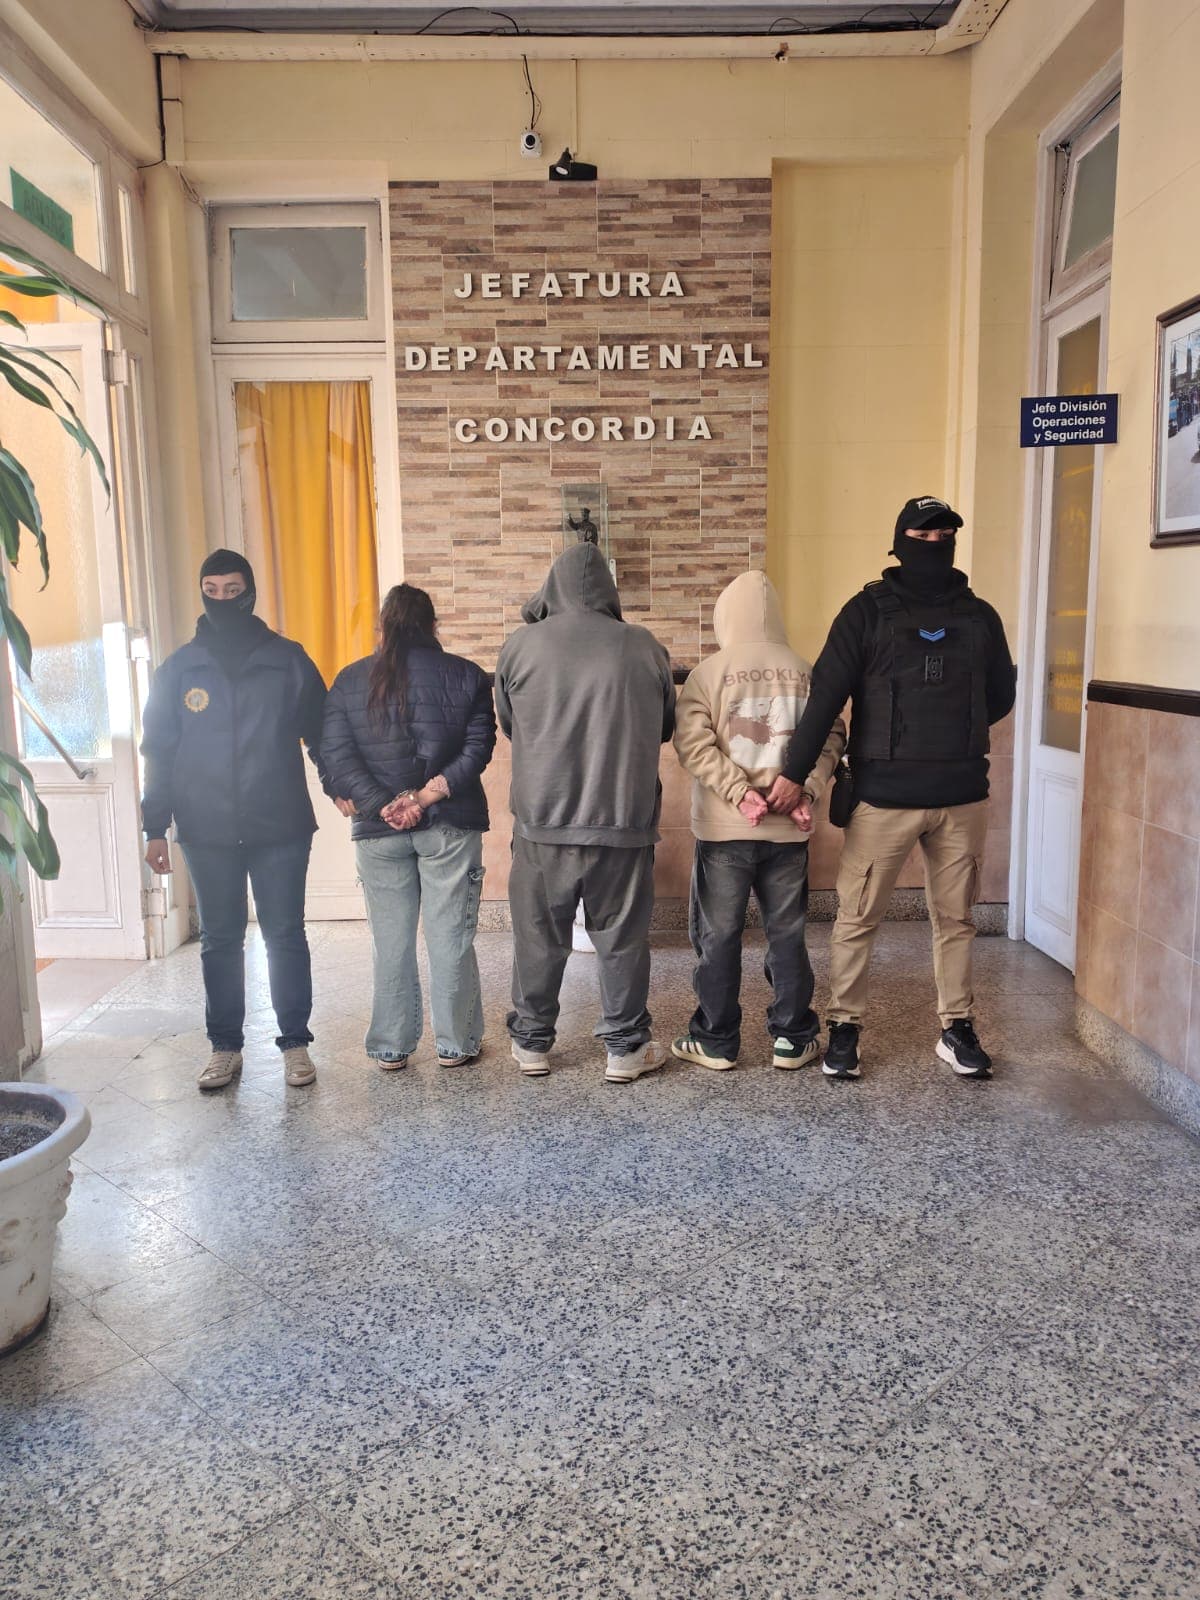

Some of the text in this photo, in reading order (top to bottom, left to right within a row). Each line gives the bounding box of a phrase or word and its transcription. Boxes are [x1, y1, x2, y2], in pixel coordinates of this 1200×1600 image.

[453, 271, 685, 299] JEFATURA
[404, 342, 764, 372] DEPARTAMENTAL
[1031, 400, 1107, 414] Jefe División
[454, 415, 713, 443] CONCORDIA
[1032, 415, 1106, 429] Operaciones
[1033, 428, 1104, 444] y Seguridad
